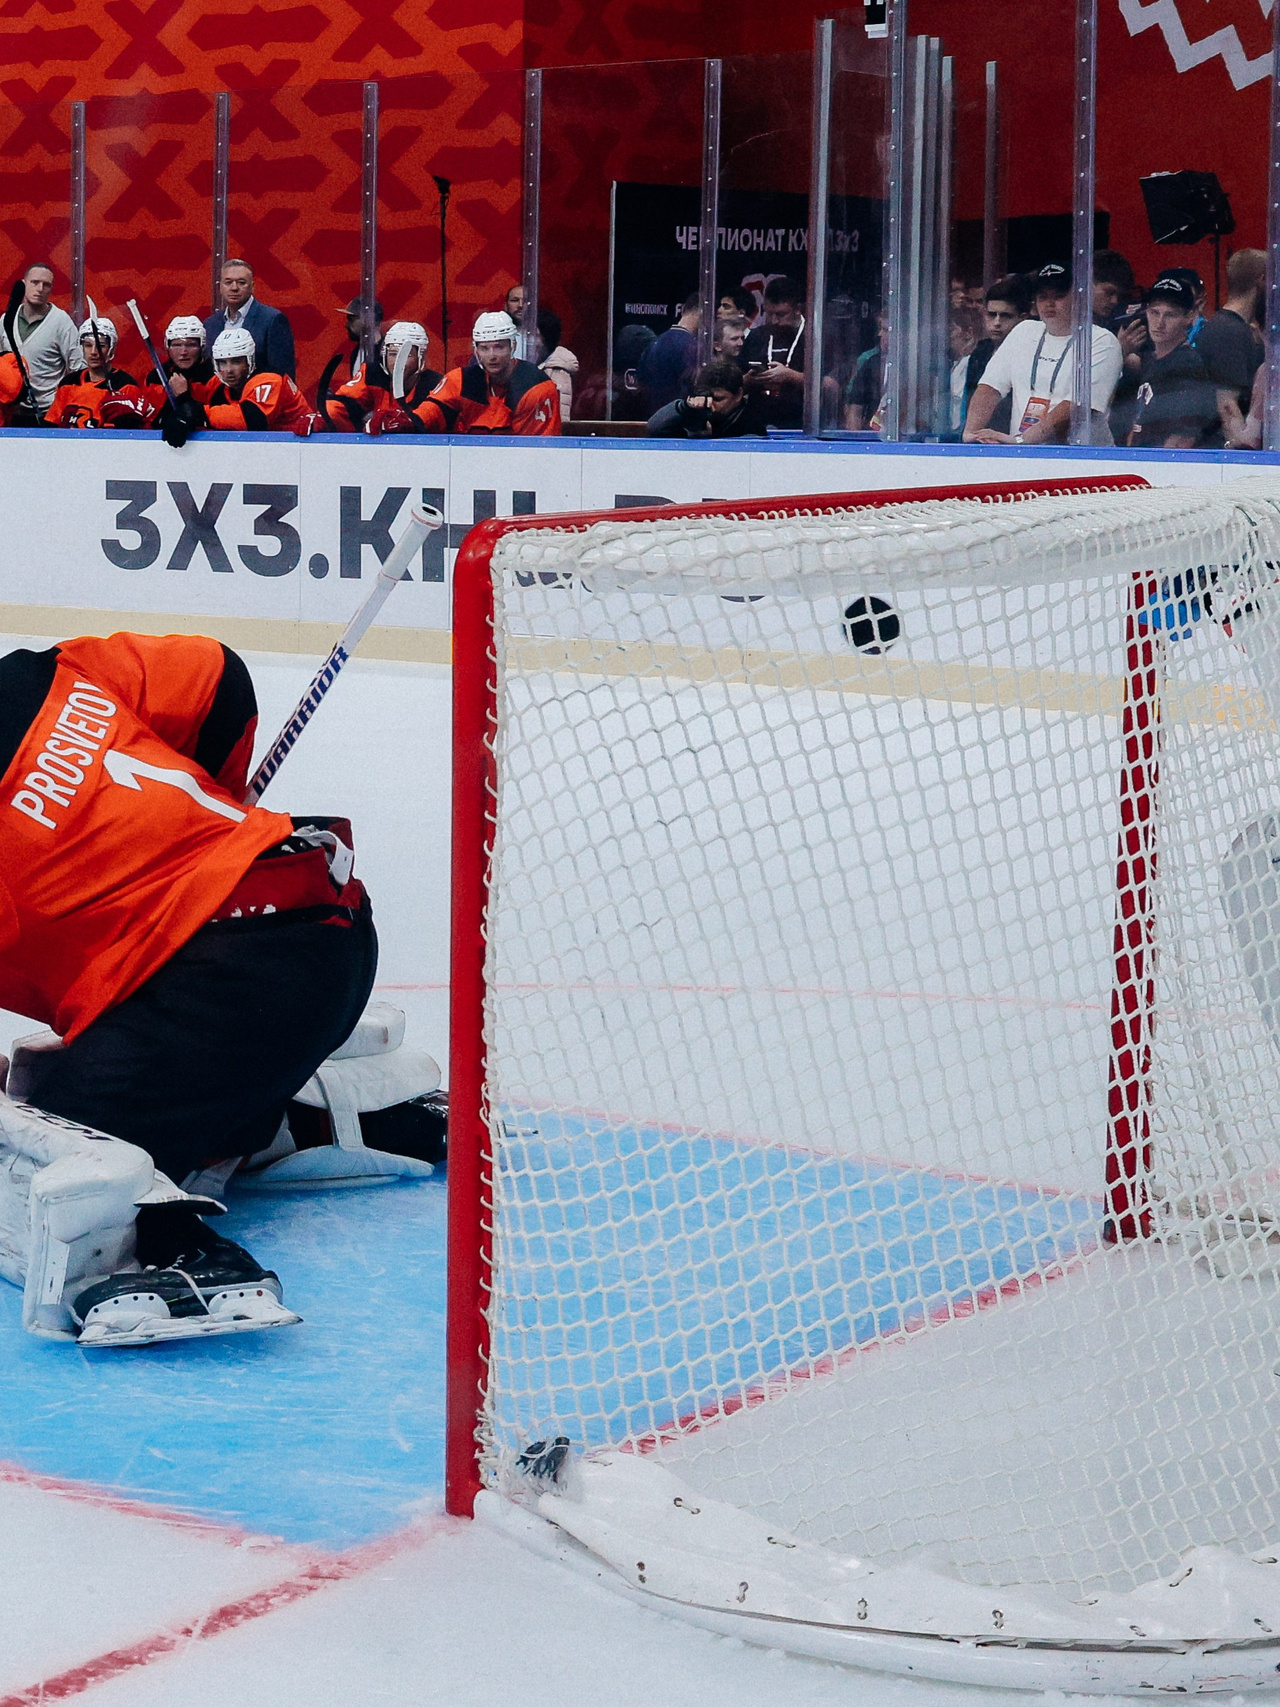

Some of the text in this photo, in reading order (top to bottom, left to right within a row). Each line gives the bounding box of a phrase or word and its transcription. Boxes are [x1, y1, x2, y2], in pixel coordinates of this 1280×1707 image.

[676, 225, 786, 251] ЧЕПИОНАТ
[254, 384, 272, 403] 17
[252, 645, 349, 799] WARRIOR
[102, 748, 248, 823] 1
